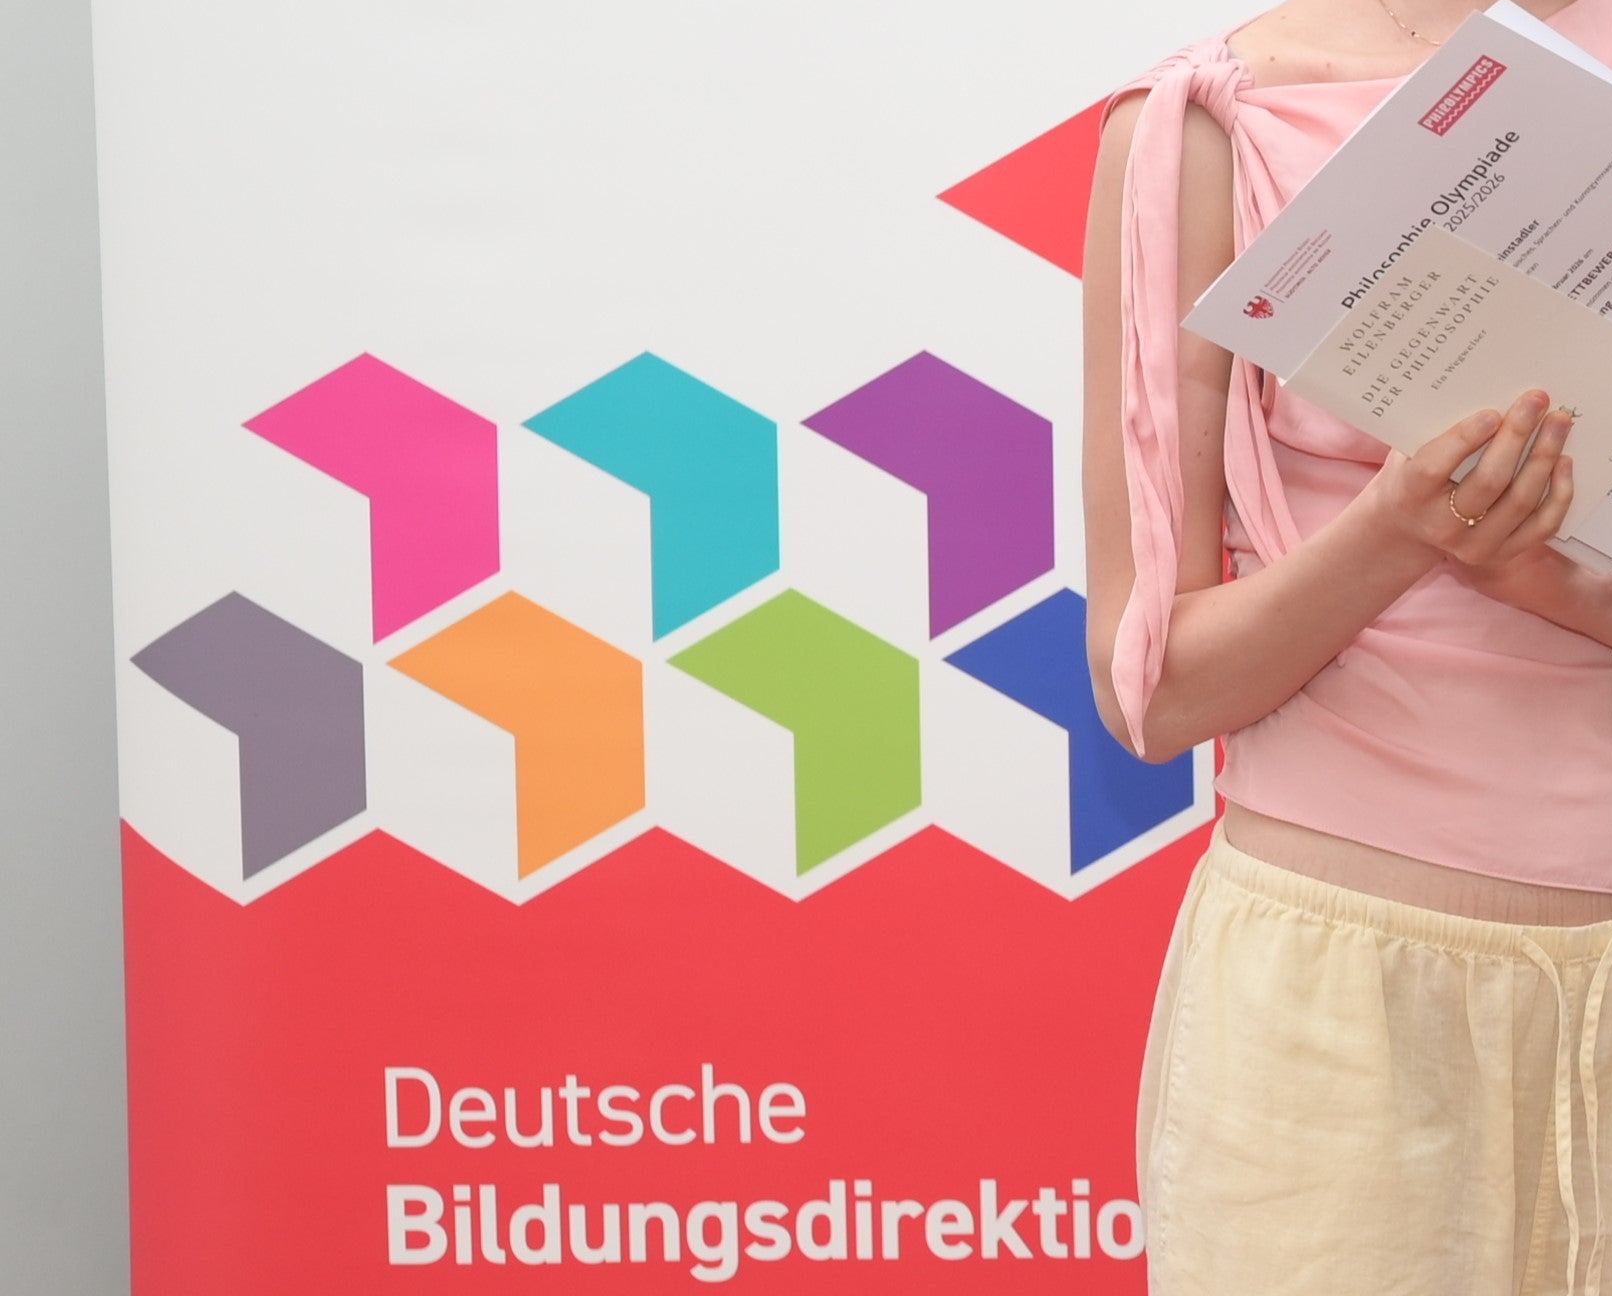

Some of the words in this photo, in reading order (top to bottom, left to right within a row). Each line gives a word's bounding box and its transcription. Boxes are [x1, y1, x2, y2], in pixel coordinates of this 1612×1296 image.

[1428, 128, 1521, 217] Olympiade
[1443, 170, 1506, 232] 2025/2026
[1339, 275, 1414, 351] WOLFRAM
[1341, 268, 1442, 376] EILENBERGER
[1361, 372, 1390, 403] DIE
[1389, 273, 1478, 370] GEGENWART
[1371, 384, 1403, 417] DER
[1401, 274, 1500, 381] PHILOSOPHIE
[1430, 373, 1448, 390] Ein
[1444, 328, 1488, 373] Wegweiser
[384, 1063, 806, 1148] Deutsche
[386, 1179, 1147, 1283] Bildungsdirektio
